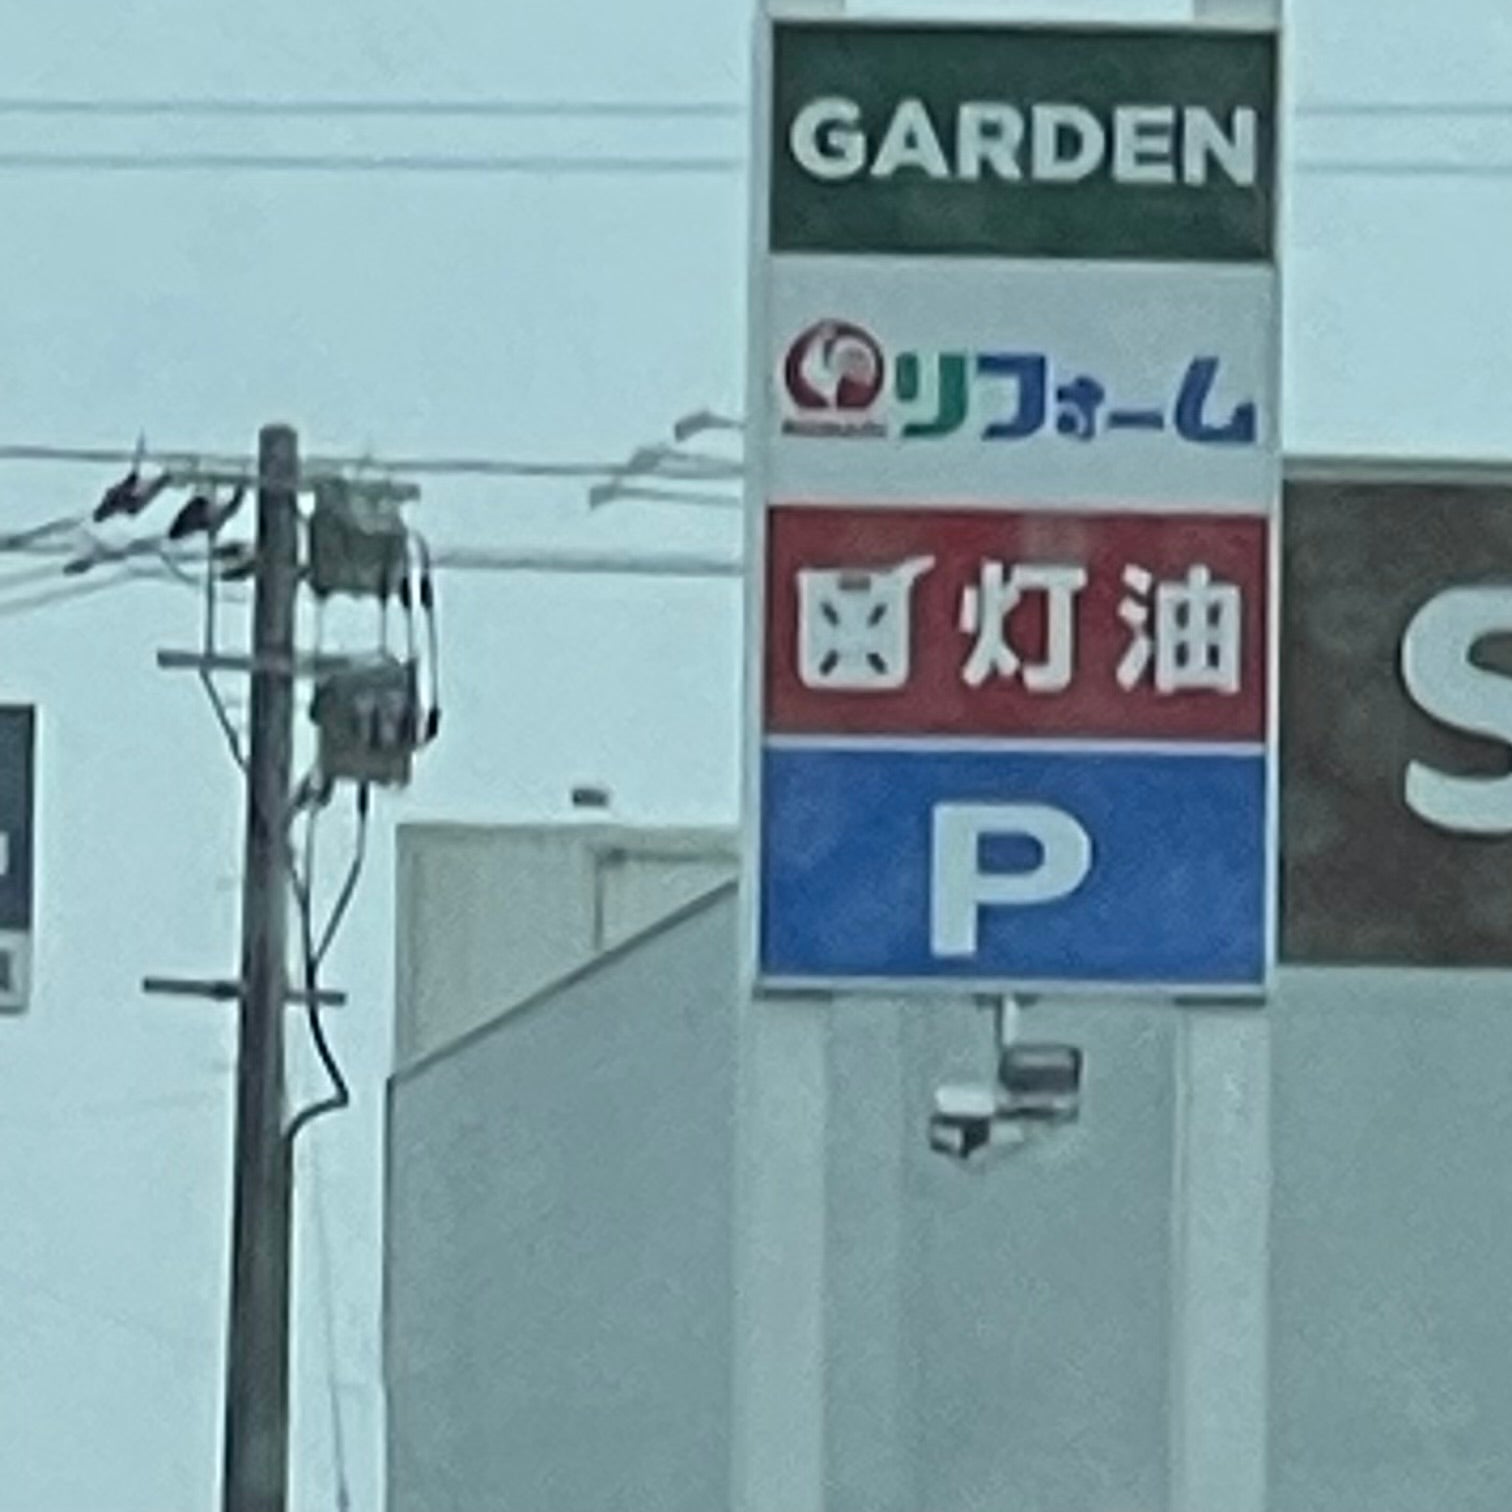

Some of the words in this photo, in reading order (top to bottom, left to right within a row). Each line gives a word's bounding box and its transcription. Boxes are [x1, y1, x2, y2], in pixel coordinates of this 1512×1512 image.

[789, 96, 1260, 188] GARDEN
[894, 350, 1258, 445] リフォーム
[958, 559, 1242, 695] 灯油
[929, 800, 1093, 960] P
